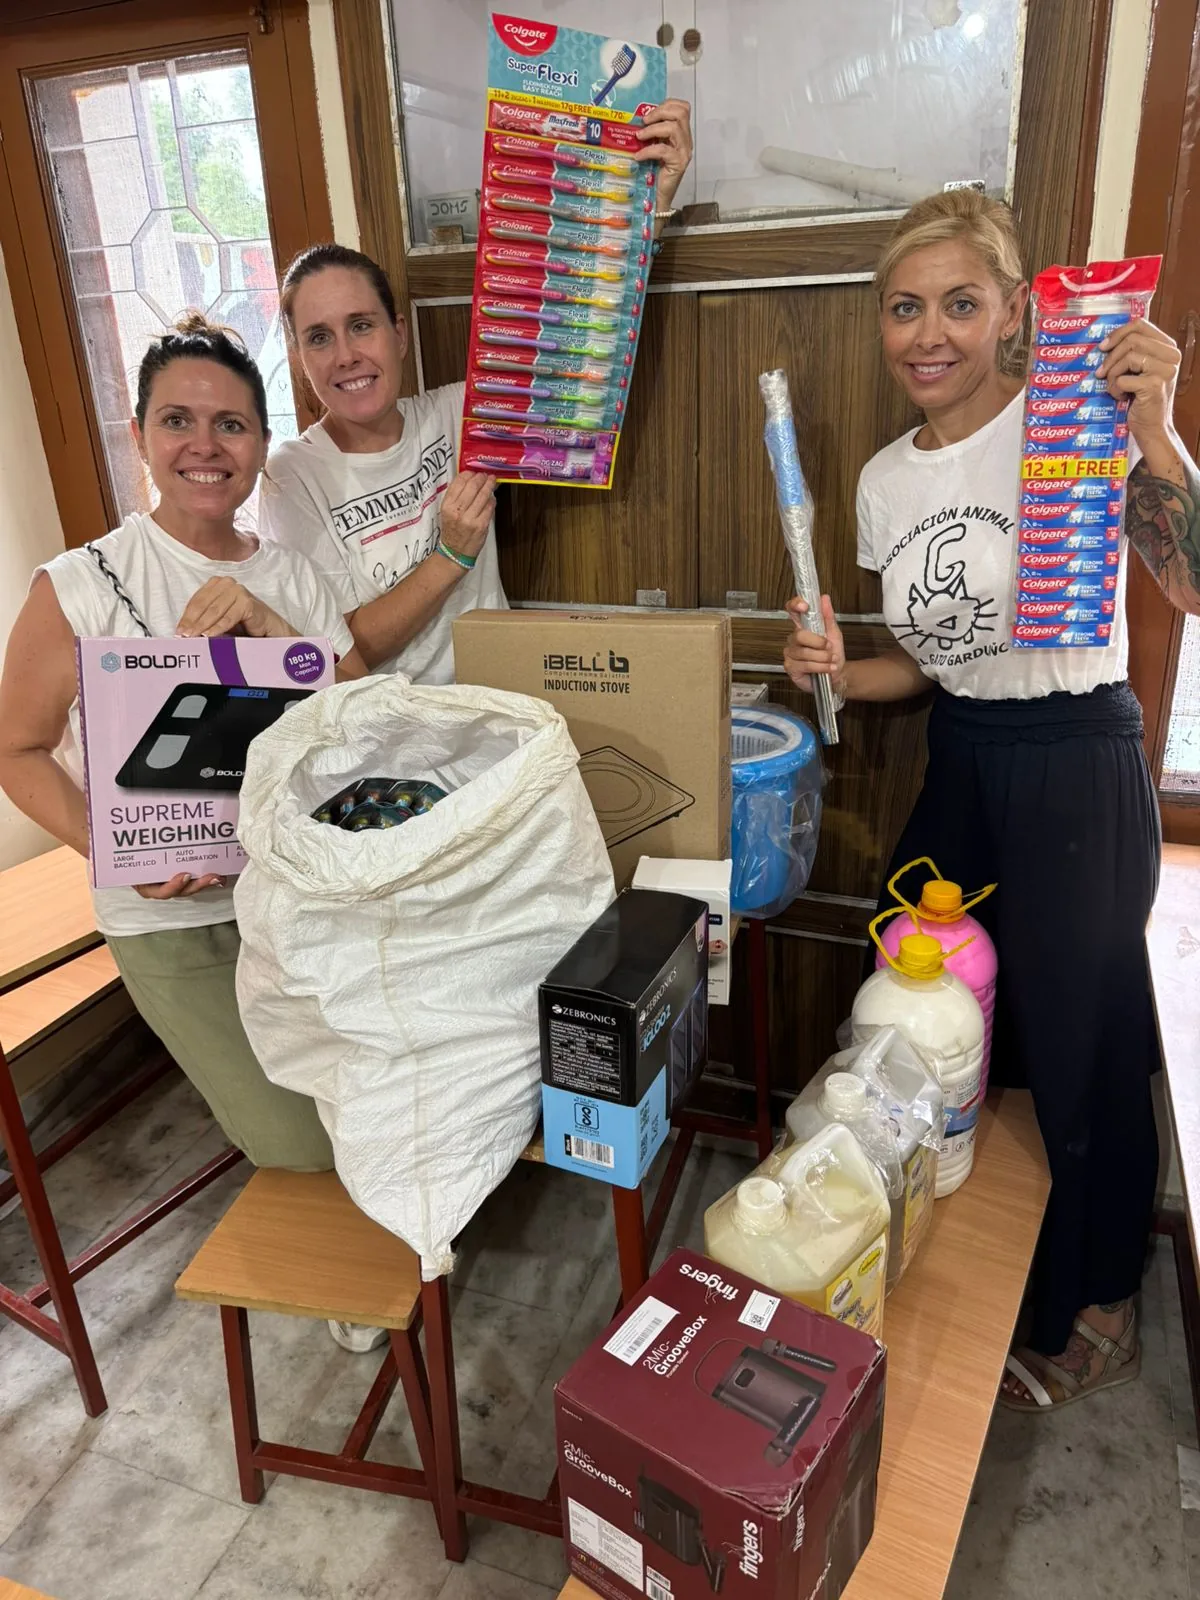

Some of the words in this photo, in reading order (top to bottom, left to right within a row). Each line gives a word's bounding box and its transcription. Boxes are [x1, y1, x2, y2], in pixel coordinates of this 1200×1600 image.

[504, 23, 548, 40] Colgate
[507, 58, 536, 73] Super
[537, 64, 579, 87] Flexi
[500, 105, 541, 121] Colgate
[561, 102, 574, 112] 17g
[573, 103, 593, 114] FREE
[581, 178, 600, 188] Flexi
[579, 205, 599, 215] Flexi
[500, 220, 533, 232] Colgate
[496, 275, 529, 286] Colgate
[493, 300, 525, 310] Colgate
[1042, 317, 1089, 329] Colgate
[491, 326, 524, 336] Colgate
[1040, 346, 1087, 358] Colgate
[1034, 373, 1081, 385] Colgate
[1032, 400, 1078, 411] Colgate
[1030, 428, 1076, 438] Colgate
[1025, 461, 1044, 477] 12
[1048, 465, 1056, 475] +
[1061, 462, 1068, 475] 1
[1076, 460, 1119, 476] FREE
[1026, 480, 1072, 490] Colgate
[1024, 505, 1070, 515] Colgate
[1023, 529, 1068, 540] Colgate
[880, 507, 958, 576] ASOCIACIÓN
[961, 506, 1015, 534] ANIMAL
[1023, 554, 1068, 564] Colgate
[1022, 579, 1067, 589] Colgate
[1021, 603, 1065, 613] Colgate
[1016, 625, 1061, 636] Colgate
[125, 654, 201, 669] BOLDFIT
[288, 655, 304, 666] 180
[304, 651, 317, 662] kg
[543, 653, 605, 672] iBELL
[929, 654, 947, 665] GATO
[294, 665, 320, 677] Capacity
[544, 679, 597, 692] INDUCTION
[600, 681, 630, 694] STOVE
[216, 769, 245, 777] BOLD
[110, 801, 215, 825] SUPREME
[112, 821, 235, 847] WEIGHING
[176, 854, 219, 863] CALIBRATION
[645, 966, 677, 1016] ZEBRONICS
[562, 1006, 617, 1026] ZEBRONICS
[679, 1263, 739, 1302] fingers
[653, 1315, 708, 1376] GrooveBox
[642, 1340, 671, 1370] 2Mic-
[563, 1440, 596, 1464] 2Mic-
[564, 1449, 633, 1499] GrooveBox
[739, 1520, 759, 1579] fingers
